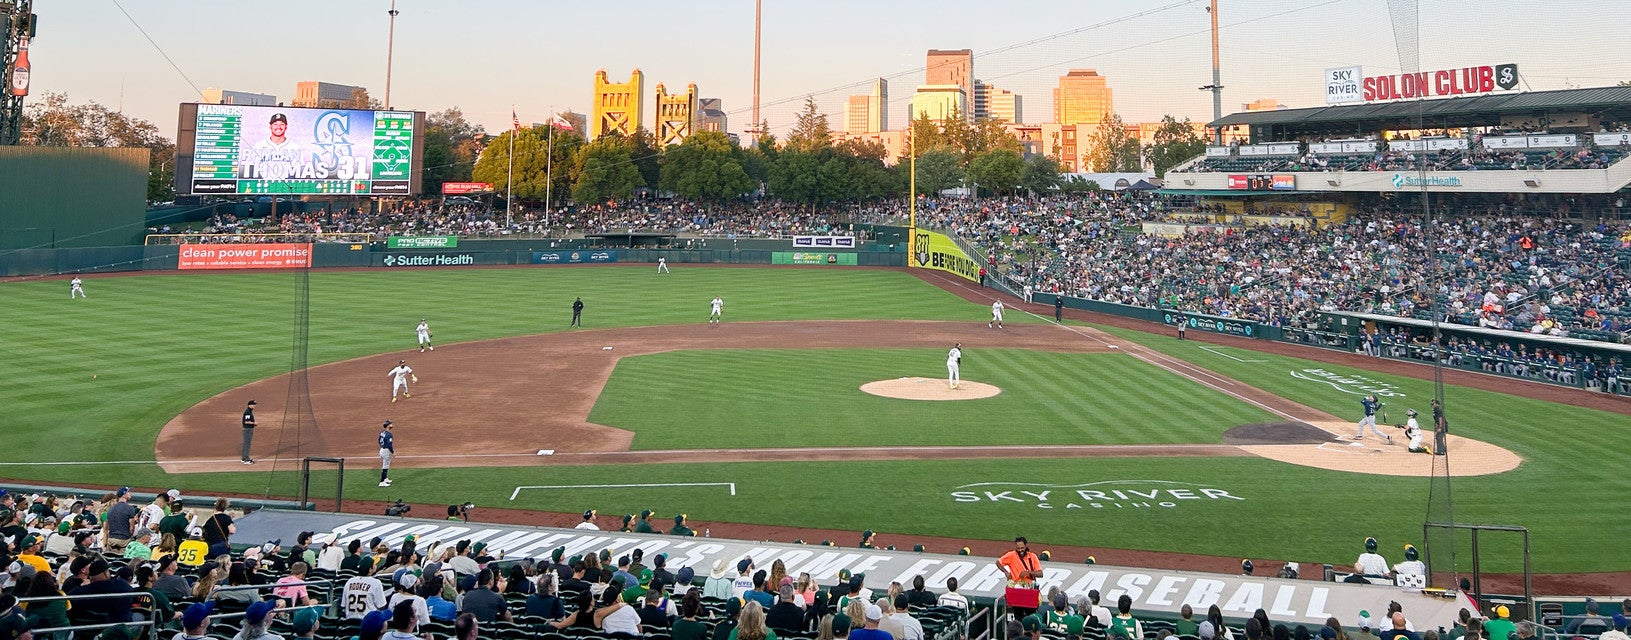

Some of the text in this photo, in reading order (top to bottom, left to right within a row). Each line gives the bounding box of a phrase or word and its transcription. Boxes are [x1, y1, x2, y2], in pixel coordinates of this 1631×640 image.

[1333, 70, 1352, 80] SKY
[1328, 84, 1358, 94] RIVER
[1363, 66, 1495, 101] SOLON CLUB
[240, 161, 329, 179] THOMAS
[337, 156, 370, 180] 31
[1406, 176, 1460, 186] Sutter Health
[916, 234, 930, 254] 811
[182, 246, 308, 261] clean power promise
[397, 254, 474, 266] Sutter Health
[932, 252, 956, 271] BEFORE
[956, 256, 965, 275] YOU
[951, 488, 1246, 502] SKY RIVER
[179, 548, 198, 562] 35
[312, 520, 1333, 618] SACRAMENTO'S HOME FOR BASEBALL
[350, 582, 371, 592] ROOKER
[349, 594, 367, 612] 25
